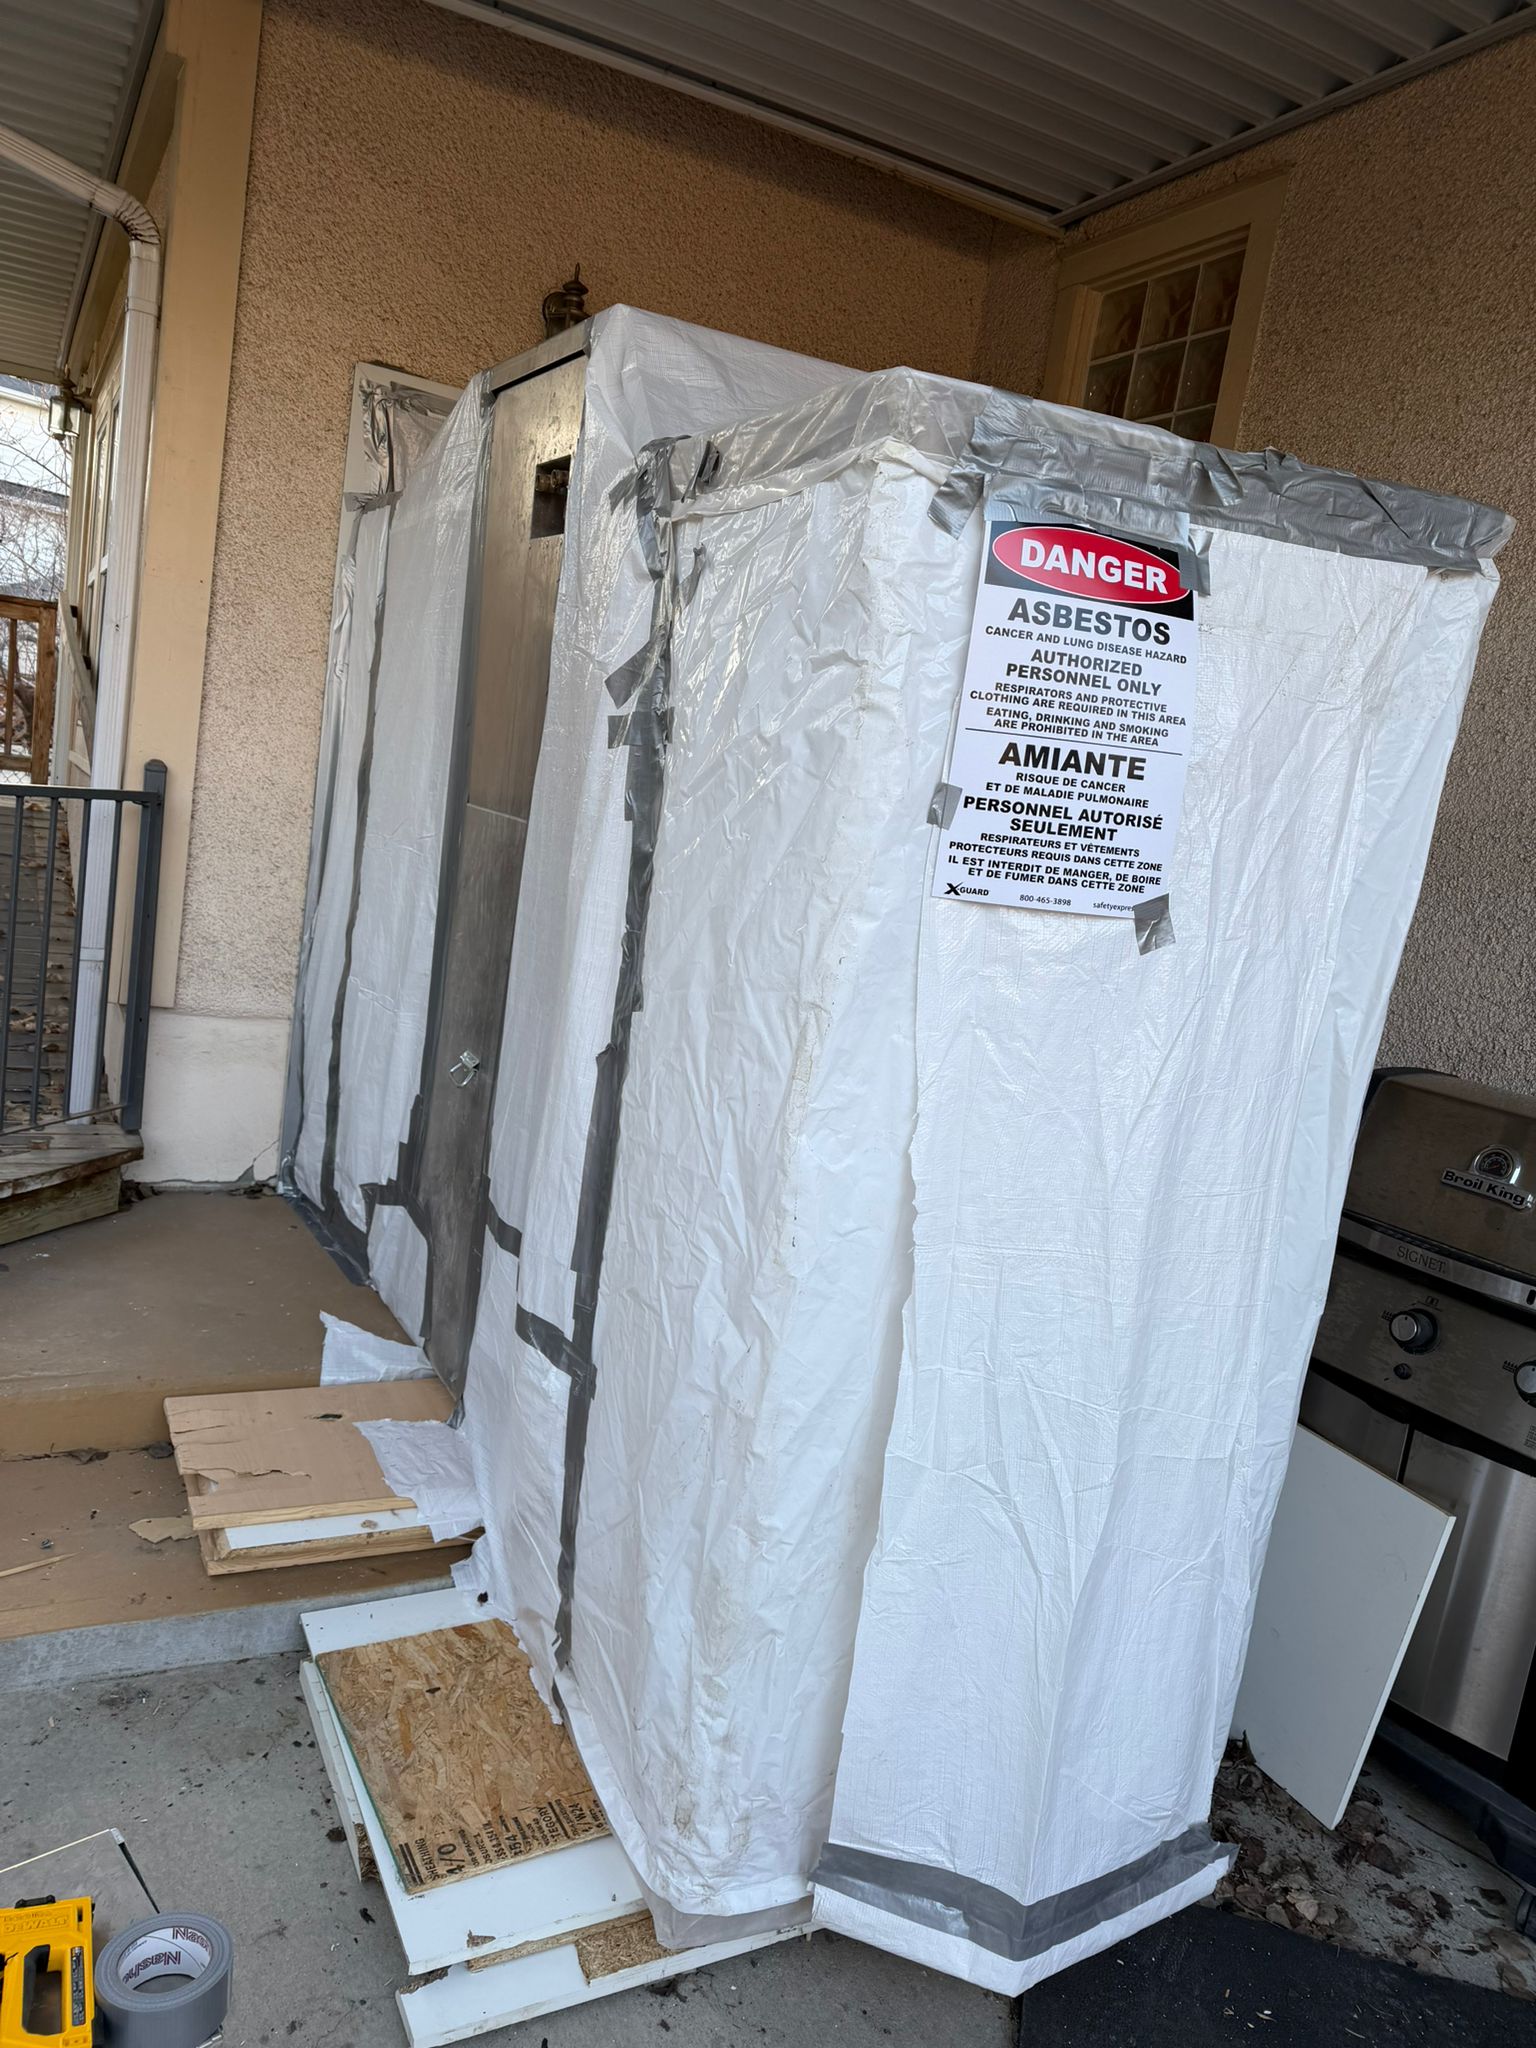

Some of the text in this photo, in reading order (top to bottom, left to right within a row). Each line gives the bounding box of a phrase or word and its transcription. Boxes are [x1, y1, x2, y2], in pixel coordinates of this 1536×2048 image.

[1021, 538, 1168, 594] DANGER
[1008, 597, 1170, 645] ASBESTOS
[985, 626, 1187, 664] CANCER AND LUNG DISEASE HAZARD
[1031, 649, 1142, 676] AUTHORIZED
[1006, 663, 1161, 696] PERSONNEL ONLY
[970, 690, 1186, 726] CLOTHING ARE REQUIRED IN THIS AREA
[995, 682, 1167, 712] RESPIRATORS AND PROTECTIVE
[986, 707, 1169, 737] EATING, DRINKING AND SMOKING
[994, 719, 1159, 746] ARE PROHIBITED IN THE AREA
[998, 742, 1146, 780] AMIANTE
[986, 782, 1149, 808] ET DE MALADIE PULMONAIRE
[1016, 772, 1126, 792] RISQUE DE CANCER
[963, 796, 1163, 830] PERSONNEL AUTORISÉ
[980, 832, 1140, 857] RESPIRATEURS ET VÊTEMENTS
[1010, 818, 1118, 841] SEULEMENT
[948, 855, 1162, 885] IL EST INTERDIT DE MANGER, DE BOIRE
[949, 841, 1163, 872] PROTECTEURS REQUIS DANS CETTE ZONE
[968, 867, 1145, 893] ET DE FUMER DANS CETTE ZONE
[1443, 1170, 1526, 1206] Broil King
[1396, 1245, 1445, 1273] SIGNET
[537, 1806, 561, 1842] TEGORY
[415, 1838, 440, 1881] SHEATHING
